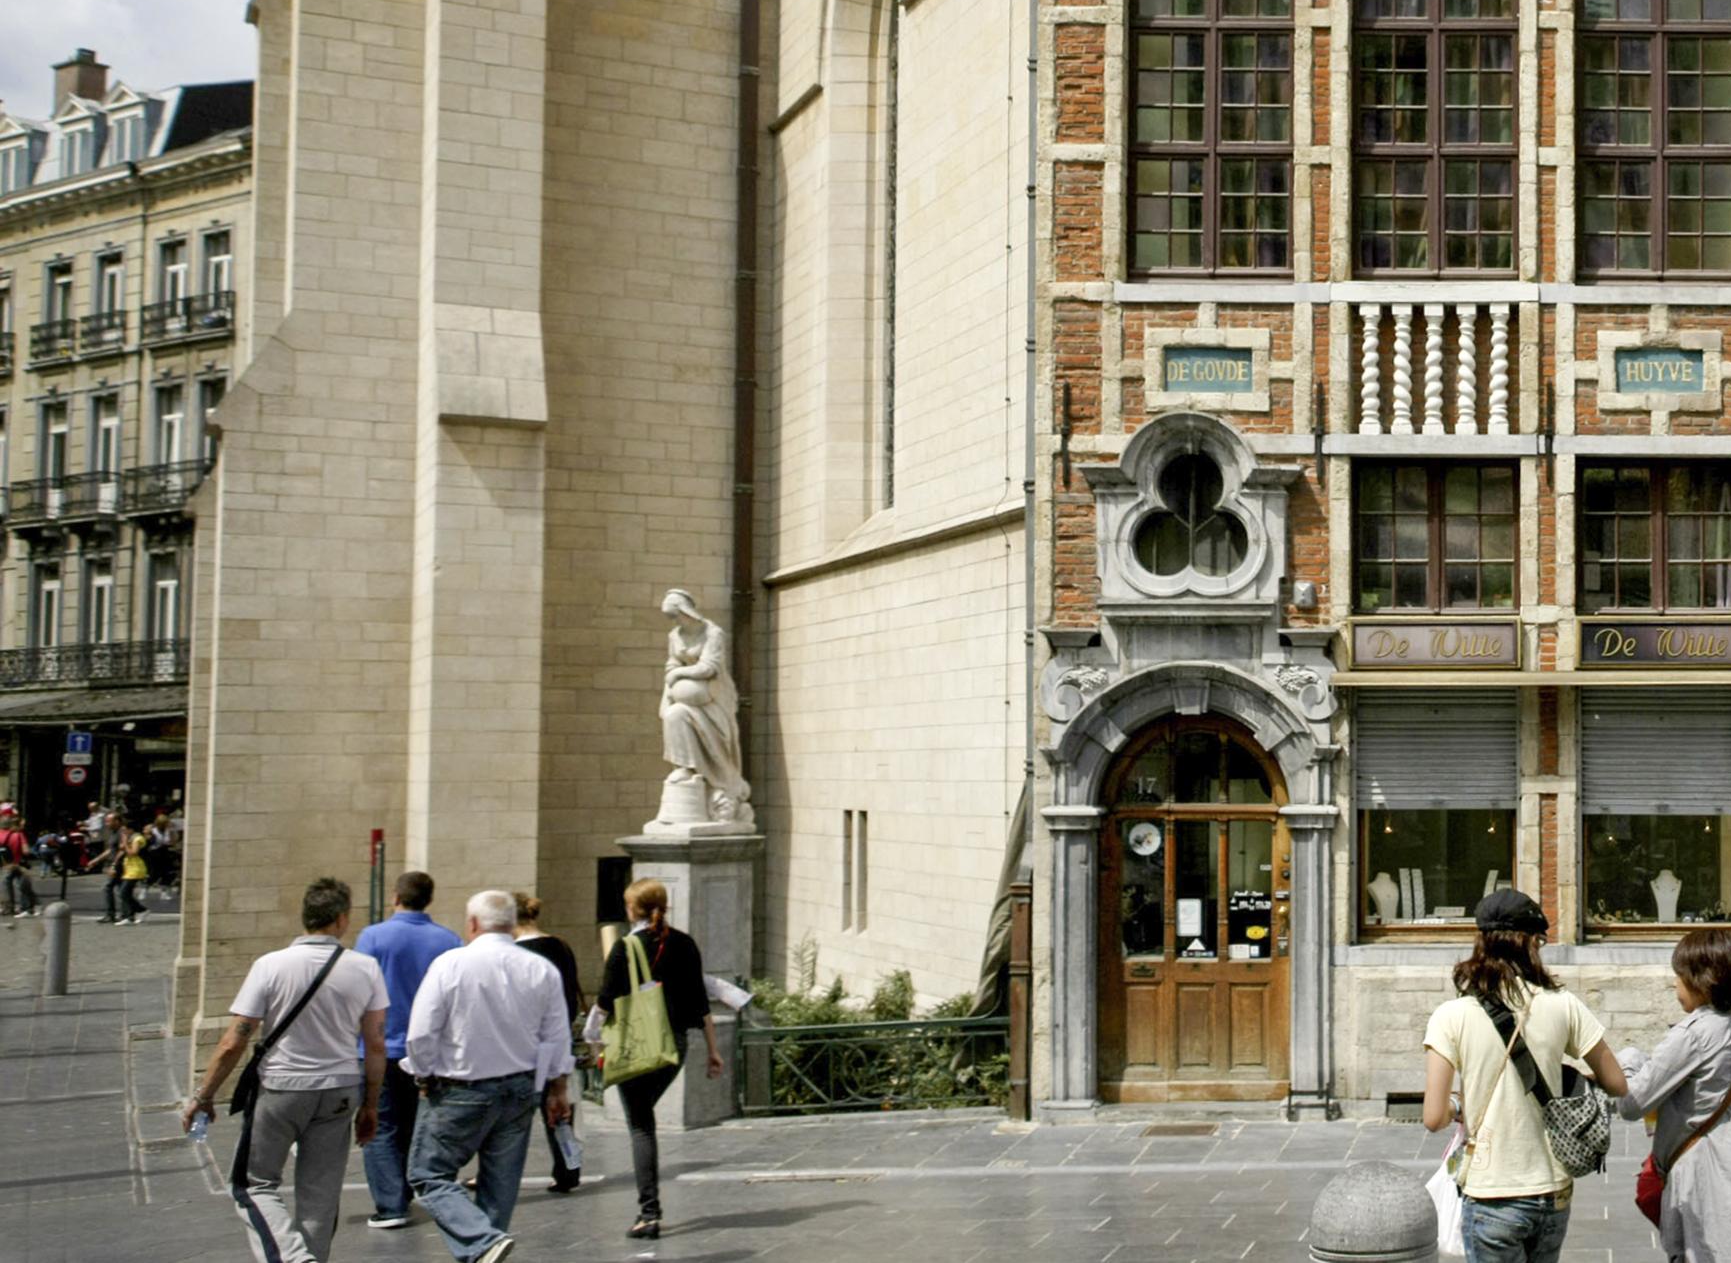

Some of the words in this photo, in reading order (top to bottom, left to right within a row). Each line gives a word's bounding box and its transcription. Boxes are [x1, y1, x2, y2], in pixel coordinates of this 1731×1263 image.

[1167, 360, 1190, 381] DE
[1193, 360, 1249, 381] GOVDE
[1626, 360, 1694, 382] HUYVE
[1367, 629, 1410, 659] De
[1594, 627, 1636, 657] De
[1137, 776, 1158, 795] 17
